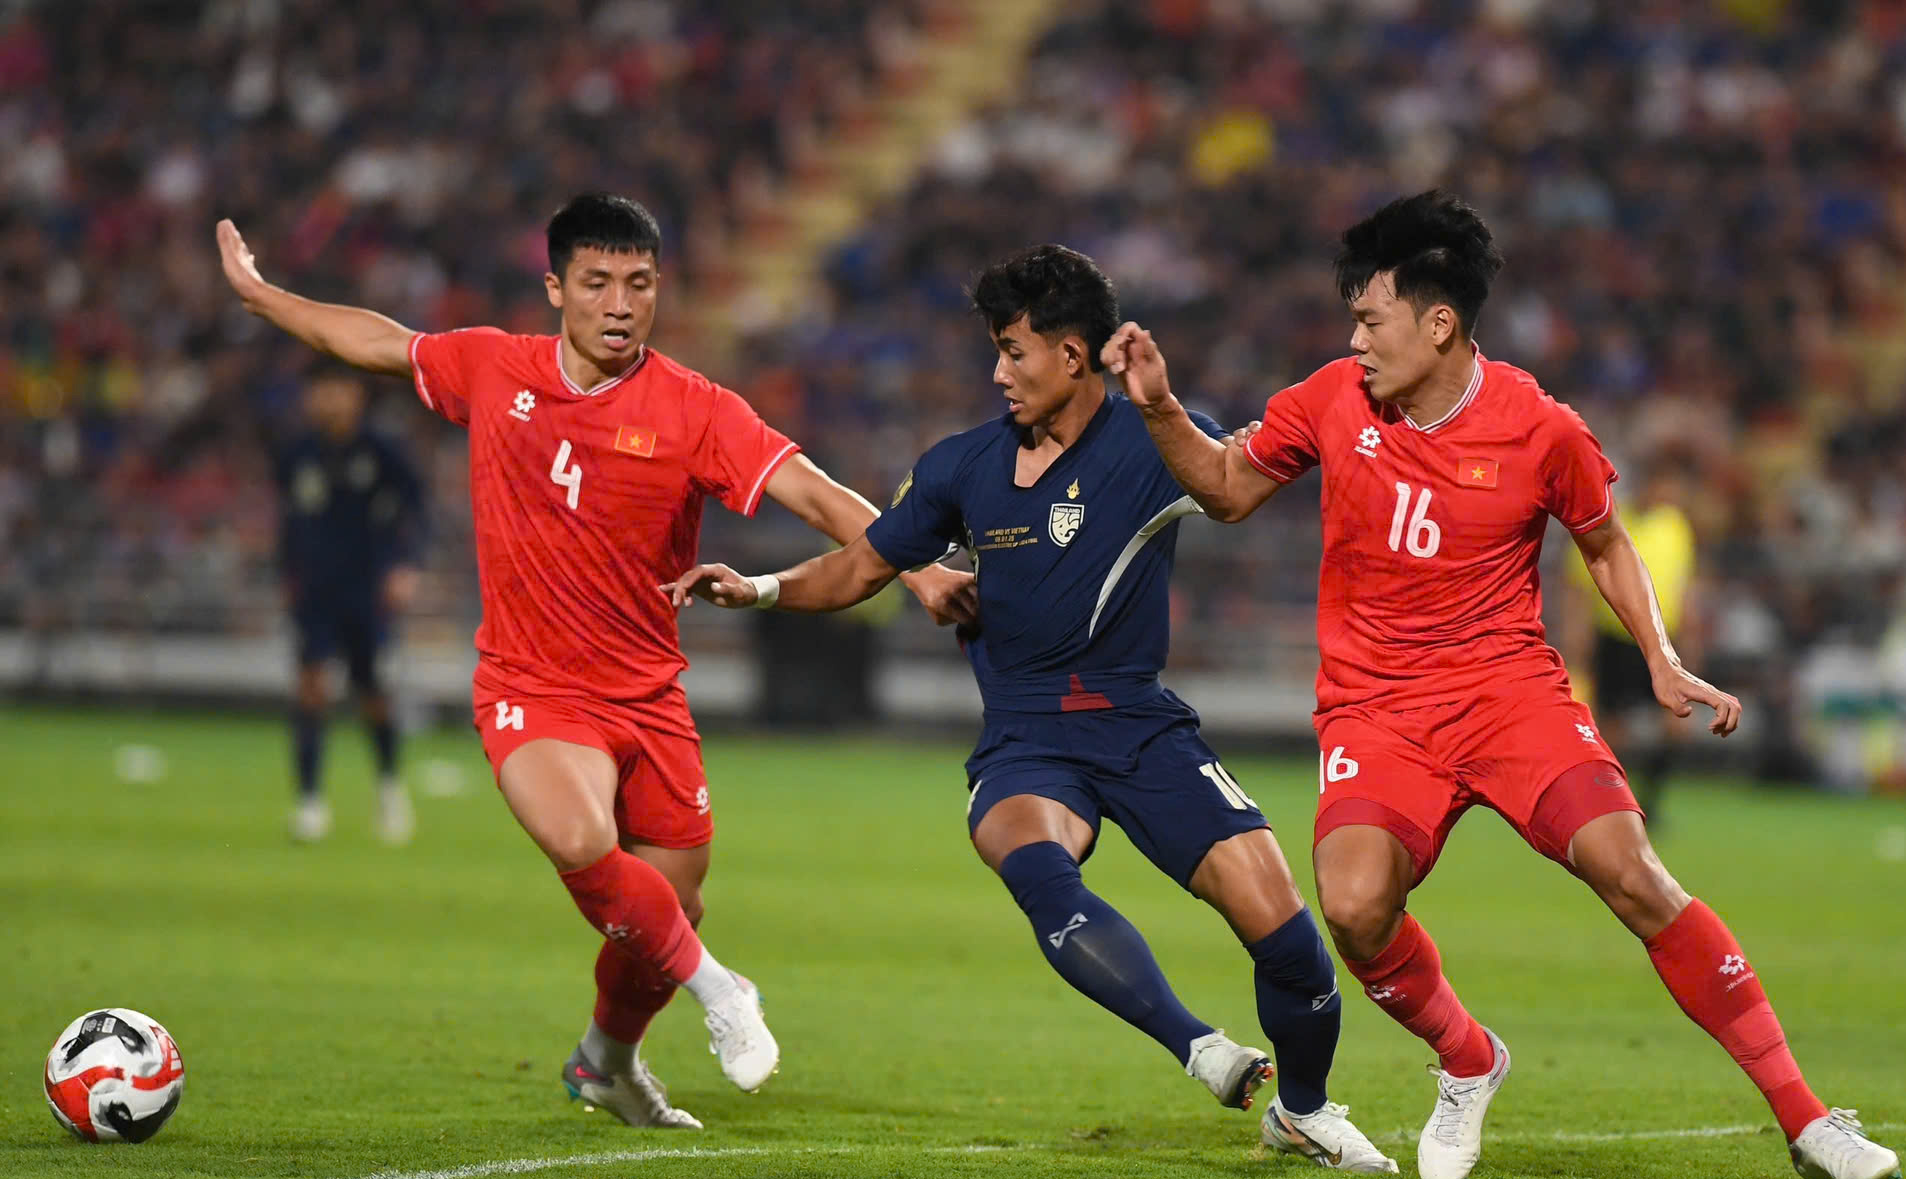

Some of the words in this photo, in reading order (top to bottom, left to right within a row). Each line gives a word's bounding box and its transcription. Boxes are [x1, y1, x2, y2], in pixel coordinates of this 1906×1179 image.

[550, 439, 583, 510] 4
[1053, 506, 1081, 514] THAILAND
[1387, 481, 1441, 559] 16
[495, 700, 524, 731] 4
[1319, 746, 1359, 795] 16
